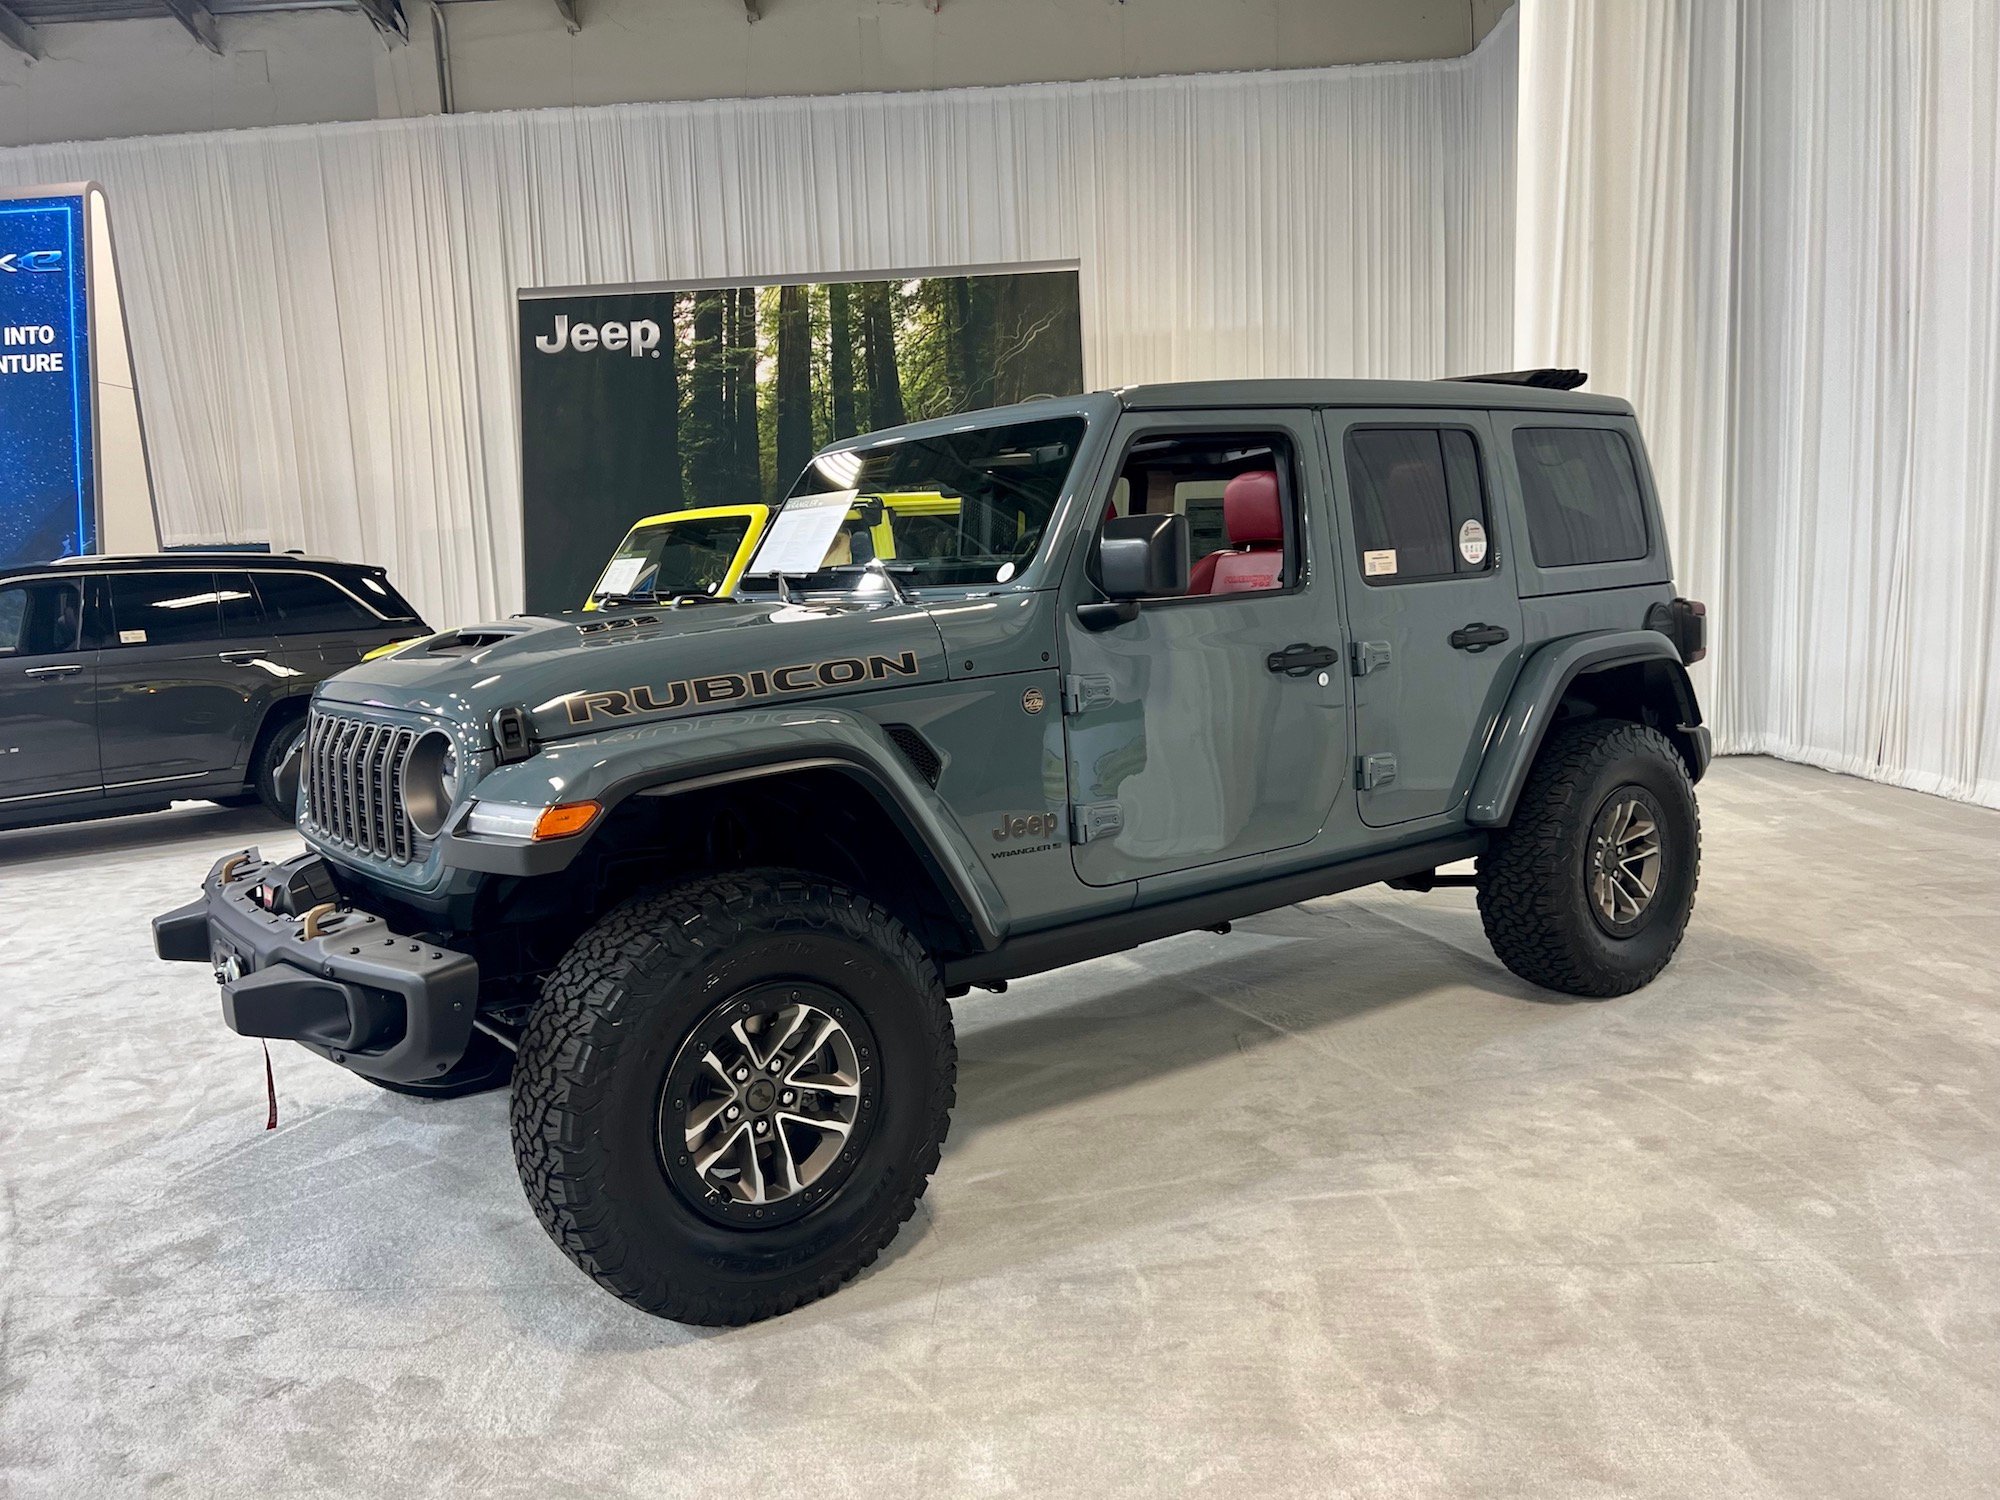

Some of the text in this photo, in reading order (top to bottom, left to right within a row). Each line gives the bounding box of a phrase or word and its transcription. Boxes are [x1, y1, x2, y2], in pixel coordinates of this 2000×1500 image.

[4, 325, 55, 346] INTO
[535, 314, 661, 357] Jeep
[565, 651, 919, 724] RUBICON
[992, 812, 1058, 841] Jeep
[991, 844, 1051, 859] WRANGLER
